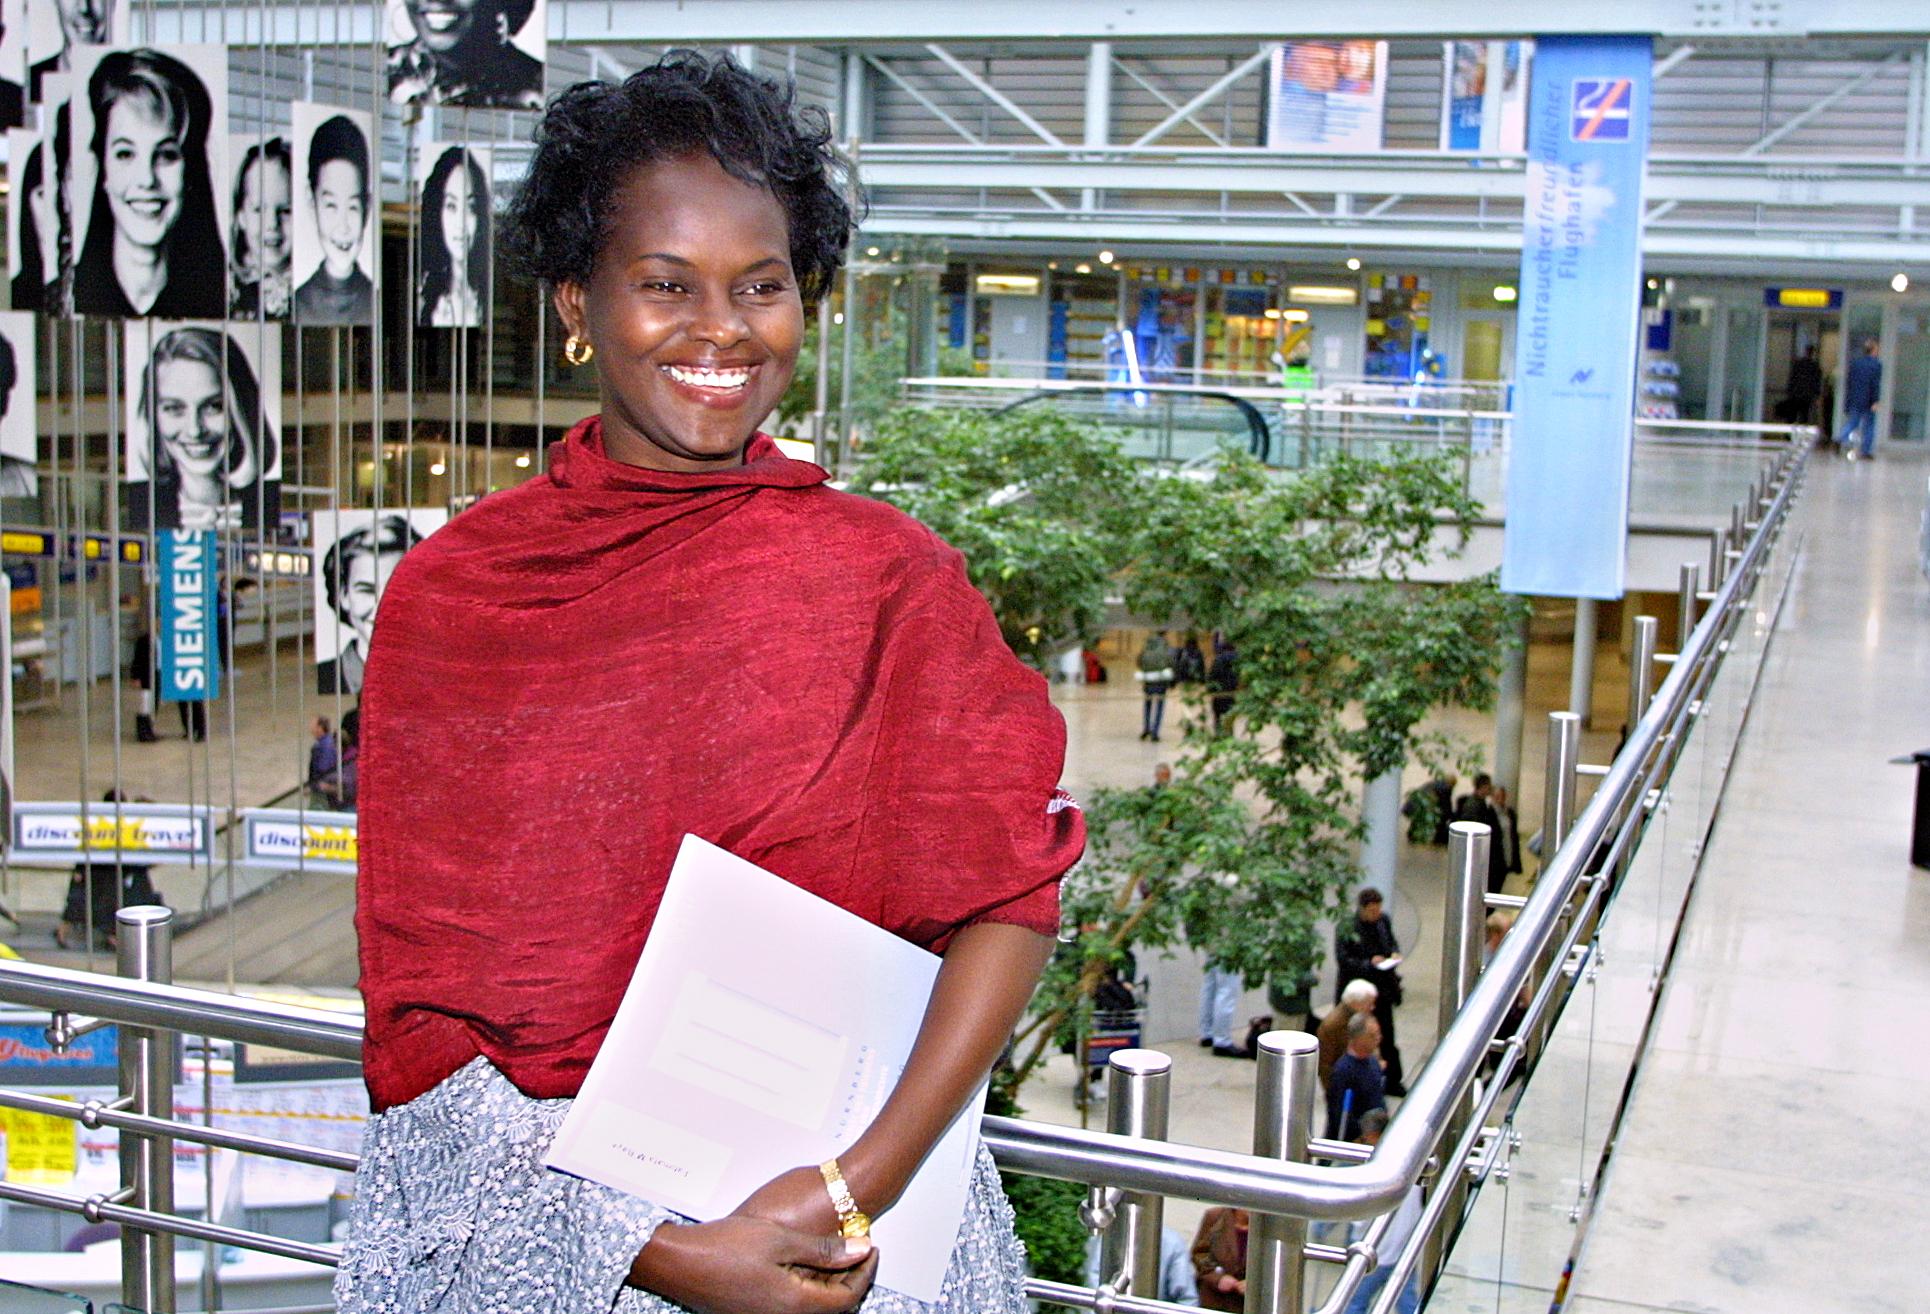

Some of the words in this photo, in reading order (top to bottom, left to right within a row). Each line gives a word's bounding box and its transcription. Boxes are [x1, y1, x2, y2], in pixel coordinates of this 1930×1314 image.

[1558, 161, 1585, 279] Flughafen
[172, 526, 205, 690] SIEMENS
[259, 831, 348, 851] discount
